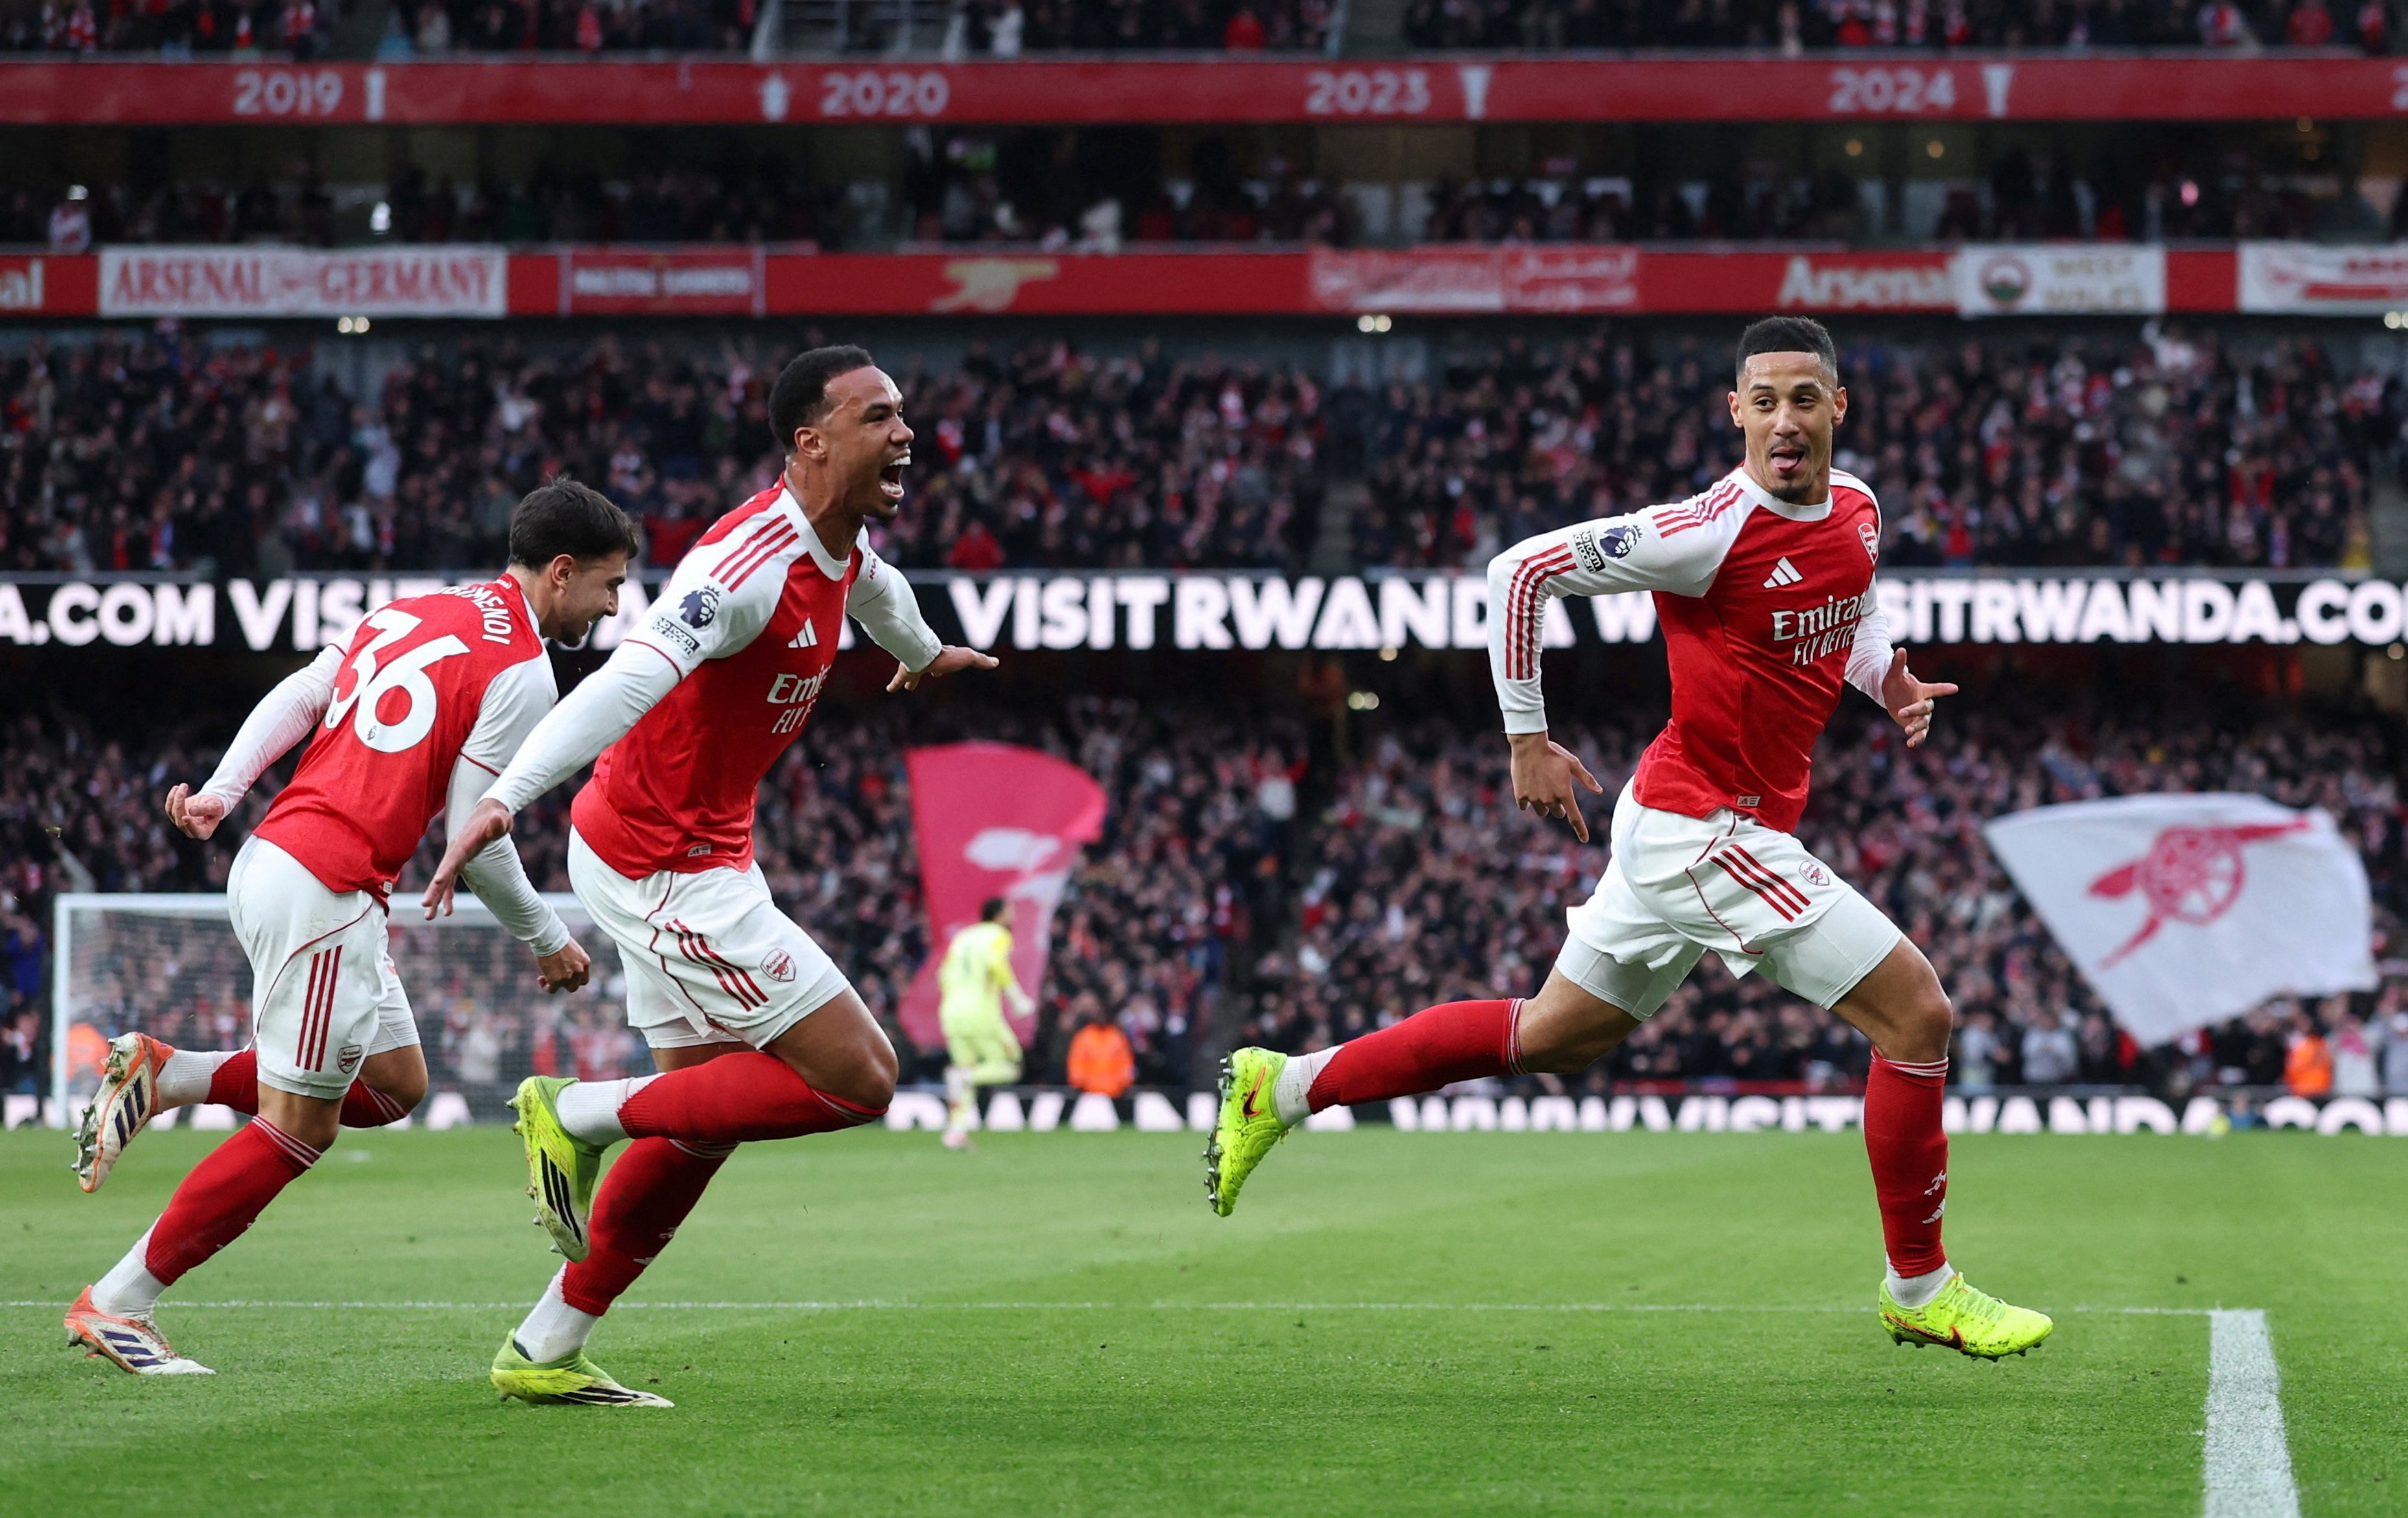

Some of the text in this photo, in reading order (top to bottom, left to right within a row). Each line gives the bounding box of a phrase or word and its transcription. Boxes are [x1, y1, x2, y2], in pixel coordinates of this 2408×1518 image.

[235, 71, 343, 115] 2019
[820, 71, 949, 116] 2020
[1305, 70, 1430, 114] 2023
[1829, 69, 1957, 111] 2024
[113, 260, 491, 303] ARSENAL GERMANY
[1584, 541, 1603, 568] room
[1791, 635, 1821, 666] FLY
[325, 608, 472, 753] 36
[771, 708, 805, 734] FLY
